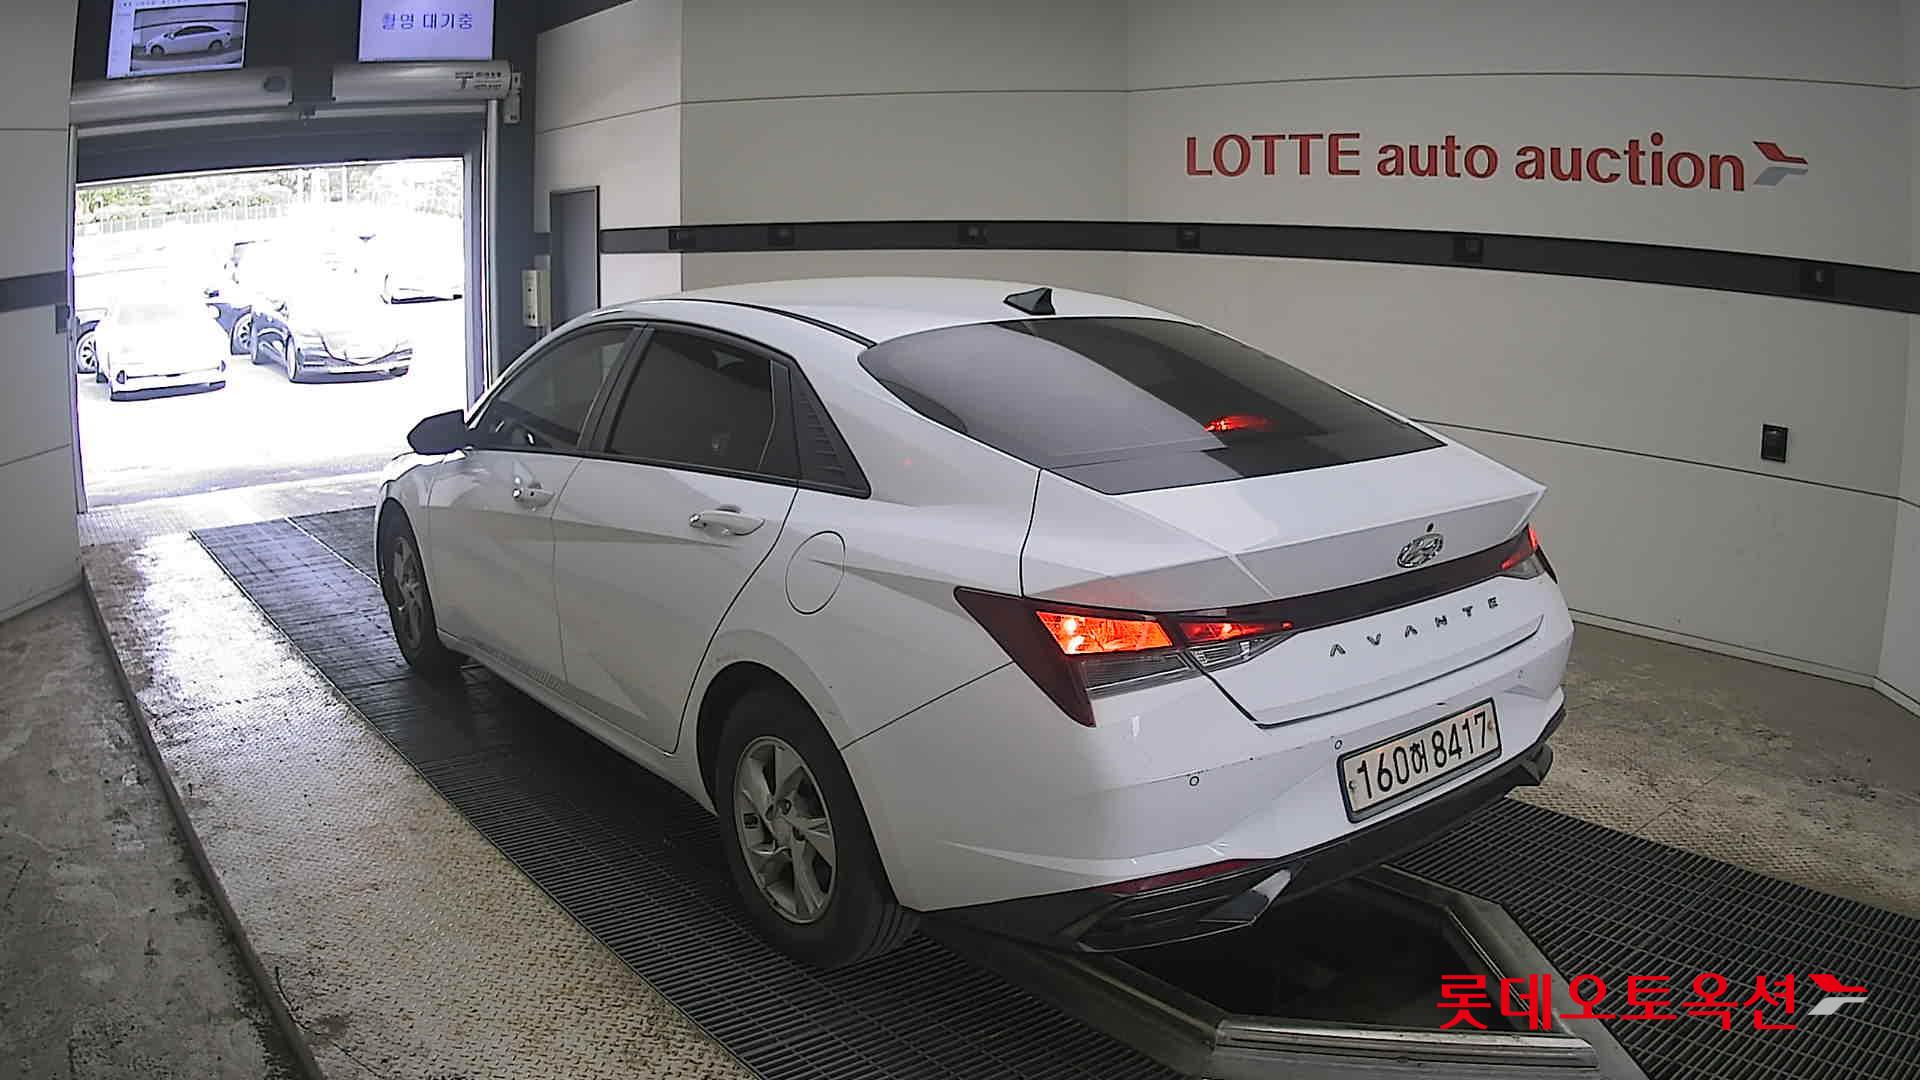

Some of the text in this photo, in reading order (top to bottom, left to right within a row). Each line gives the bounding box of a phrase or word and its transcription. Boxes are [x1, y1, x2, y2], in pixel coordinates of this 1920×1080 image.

[1185, 131, 1746, 192] LOTTE auto auction
[1329, 596, 1499, 657] AVANTE
